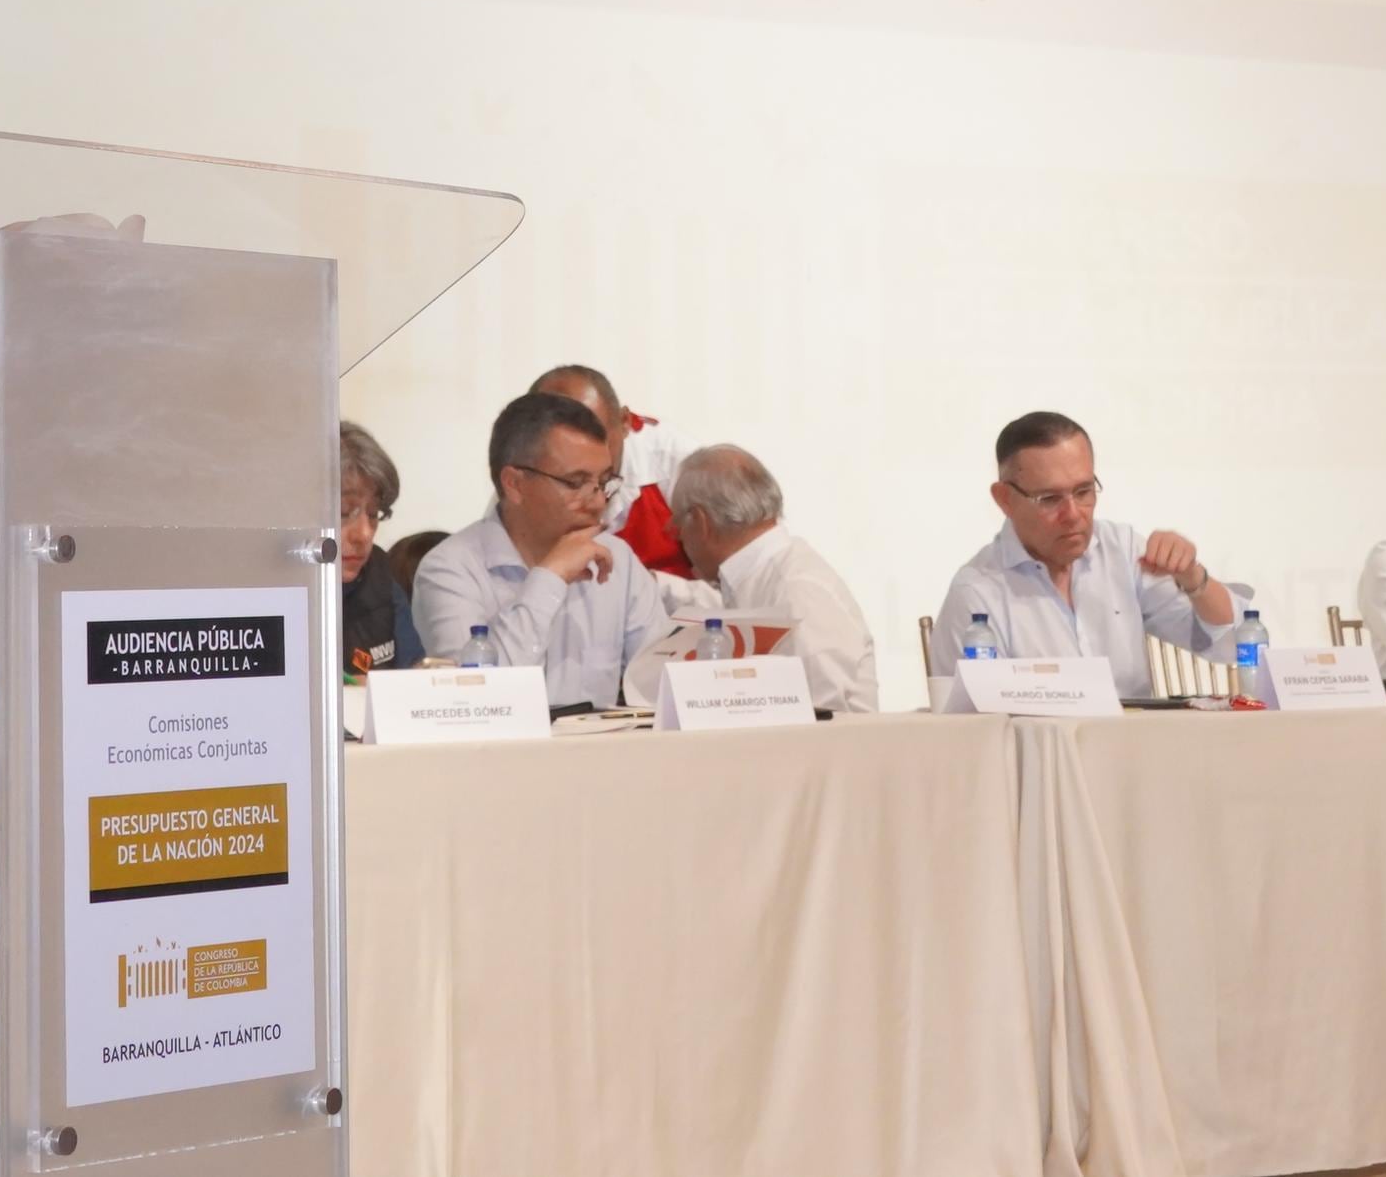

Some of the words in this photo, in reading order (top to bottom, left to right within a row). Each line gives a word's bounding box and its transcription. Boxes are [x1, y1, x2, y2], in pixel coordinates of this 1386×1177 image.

[105, 631, 194, 655] AUDIENCIA
[198, 625, 264, 651] PÚBLICA
[685, 697, 721, 709] WILLIAM
[723, 696, 766, 708] CAMARGO
[769, 695, 800, 706] TRIANA
[1000, 690, 1043, 700] RICARDO
[1044, 690, 1085, 700] BONILLA
[411, 708, 471, 720] MERCEDES
[474, 706, 513, 718] GÓMEZ
[148, 714, 229, 734] Comisiones
[108, 743, 193, 764] Económicas
[198, 739, 268, 763] Conjuntas
[101, 810, 208, 837] PRESUPUESTO
[213, 804, 279, 828] GENERAL
[118, 845, 137, 865] DE
[143, 843, 162, 863] LA
[166, 833, 222, 860] NACIÓN
[228, 834, 264, 856] 2024
[194, 948, 239, 962] CONGRESO
[194, 967, 206, 978] DE
[206, 966, 217, 976] LA
[194, 982, 205, 993] DE
[206, 977, 248, 992] COLOMBIA
[103, 1036, 201, 1064] BARRANQUILLA
[213, 1023, 281, 1049] ATLÁNTICO
